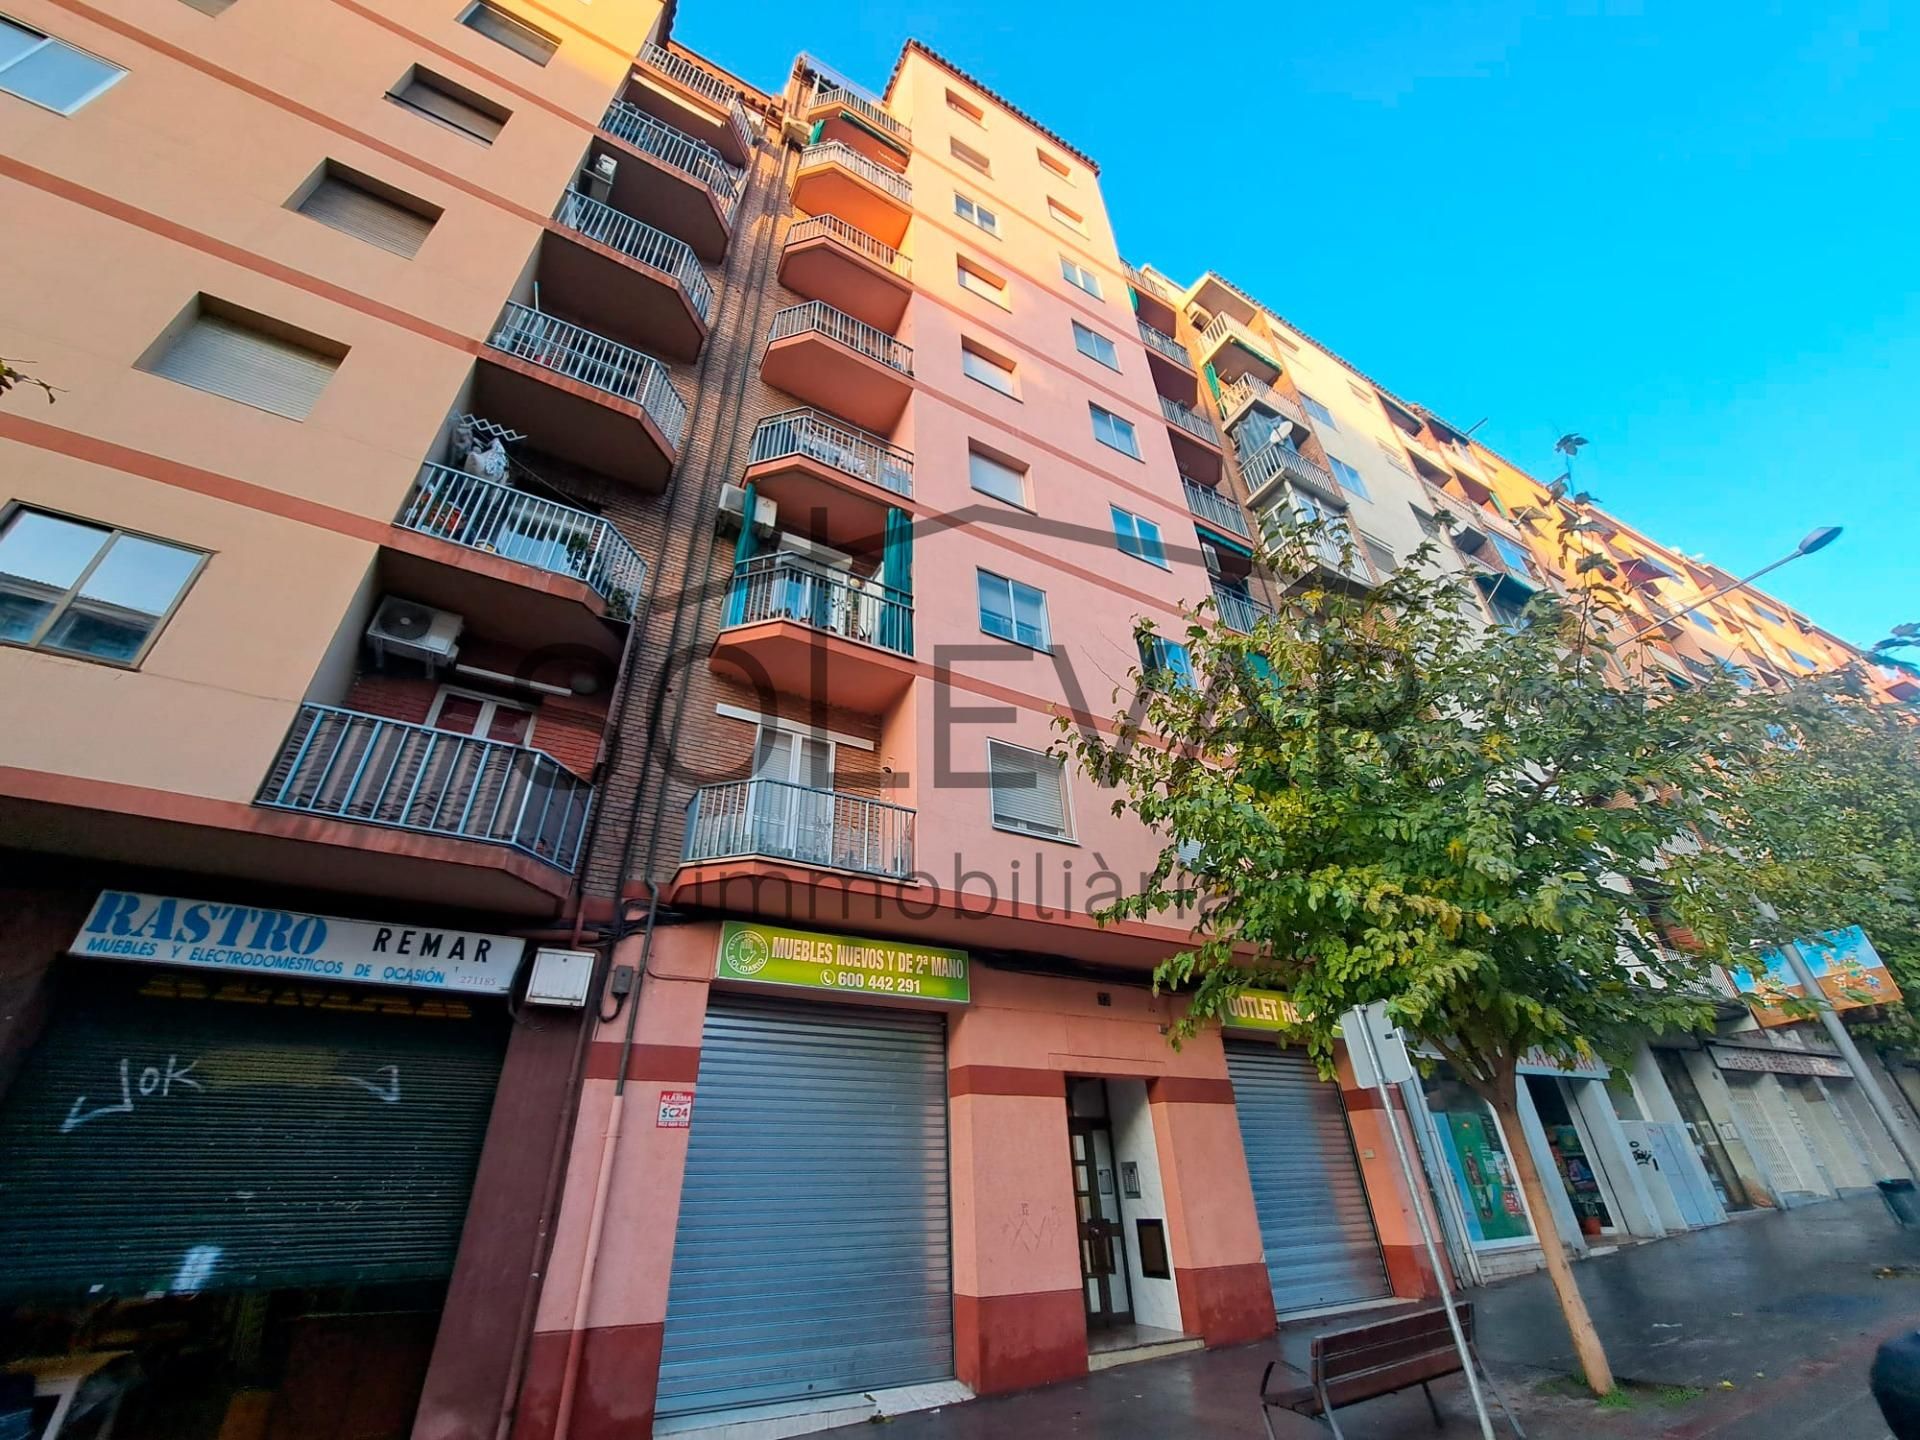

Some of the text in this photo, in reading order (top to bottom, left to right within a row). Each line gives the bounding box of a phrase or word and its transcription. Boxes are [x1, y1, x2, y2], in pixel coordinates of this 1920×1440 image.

[85, 892, 492, 963] RASTRO REMAR
[87, 937, 445, 984] MUEBLES Y ELECTRODOMESTICOS DE OCASIÓN
[771, 936, 964, 979] MUEBLES NUEVOS Y DE 2ª MANO
[838, 973, 921, 994] 600 442 291
[1226, 995, 1278, 1021] OUTLET
